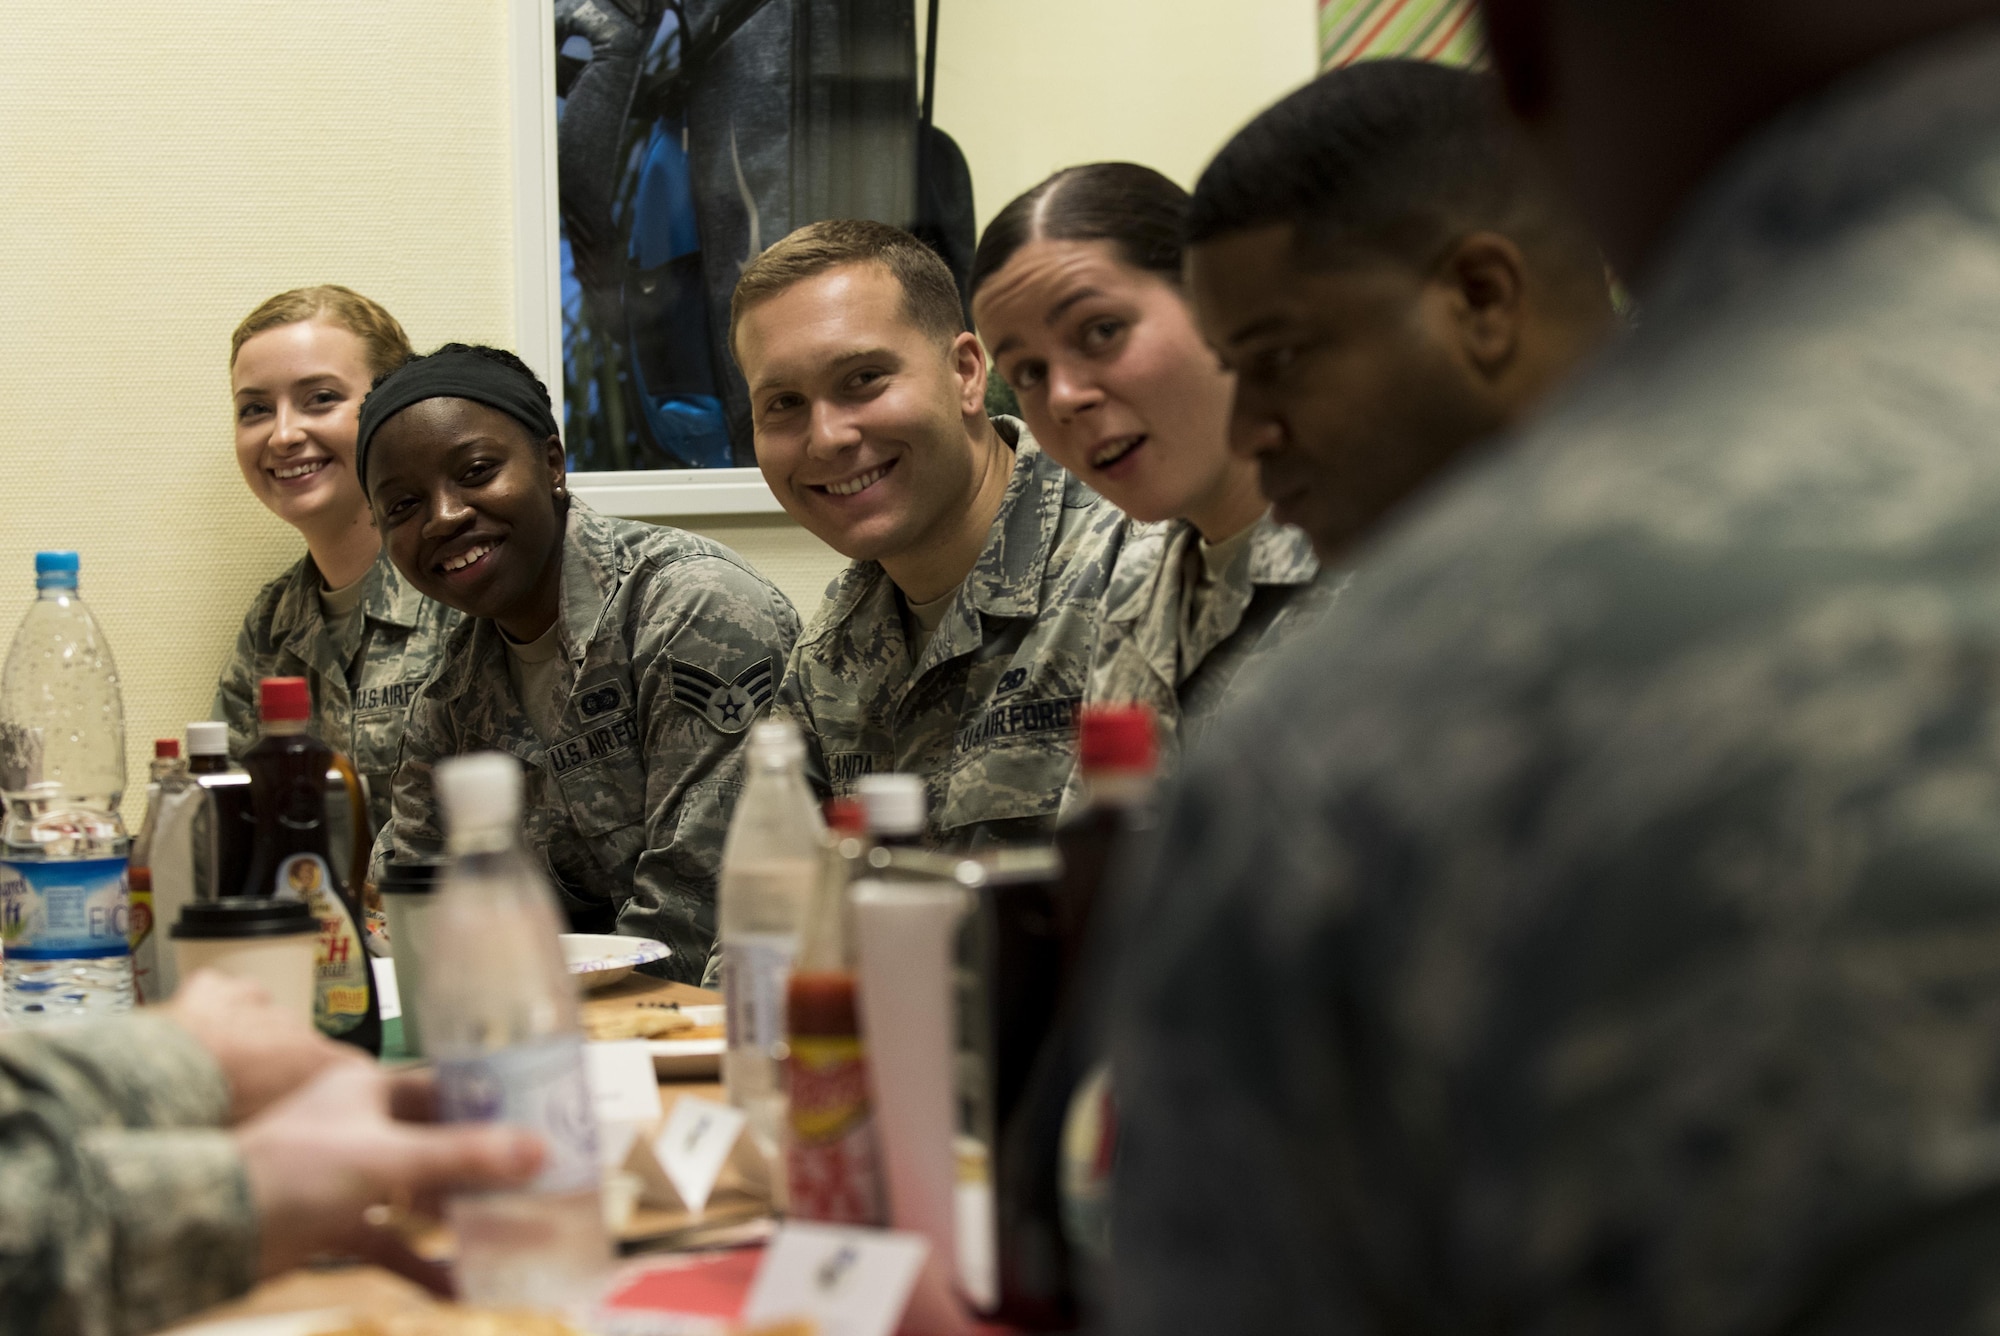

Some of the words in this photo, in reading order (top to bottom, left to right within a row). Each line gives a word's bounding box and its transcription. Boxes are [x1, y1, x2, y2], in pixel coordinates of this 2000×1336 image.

[357, 689, 379, 710] U.S.
[381, 684, 402, 707] AIR
[982, 709, 1005, 738] AIR
[550, 742, 587, 771] U.S.
[586, 730, 615, 757] AIR
